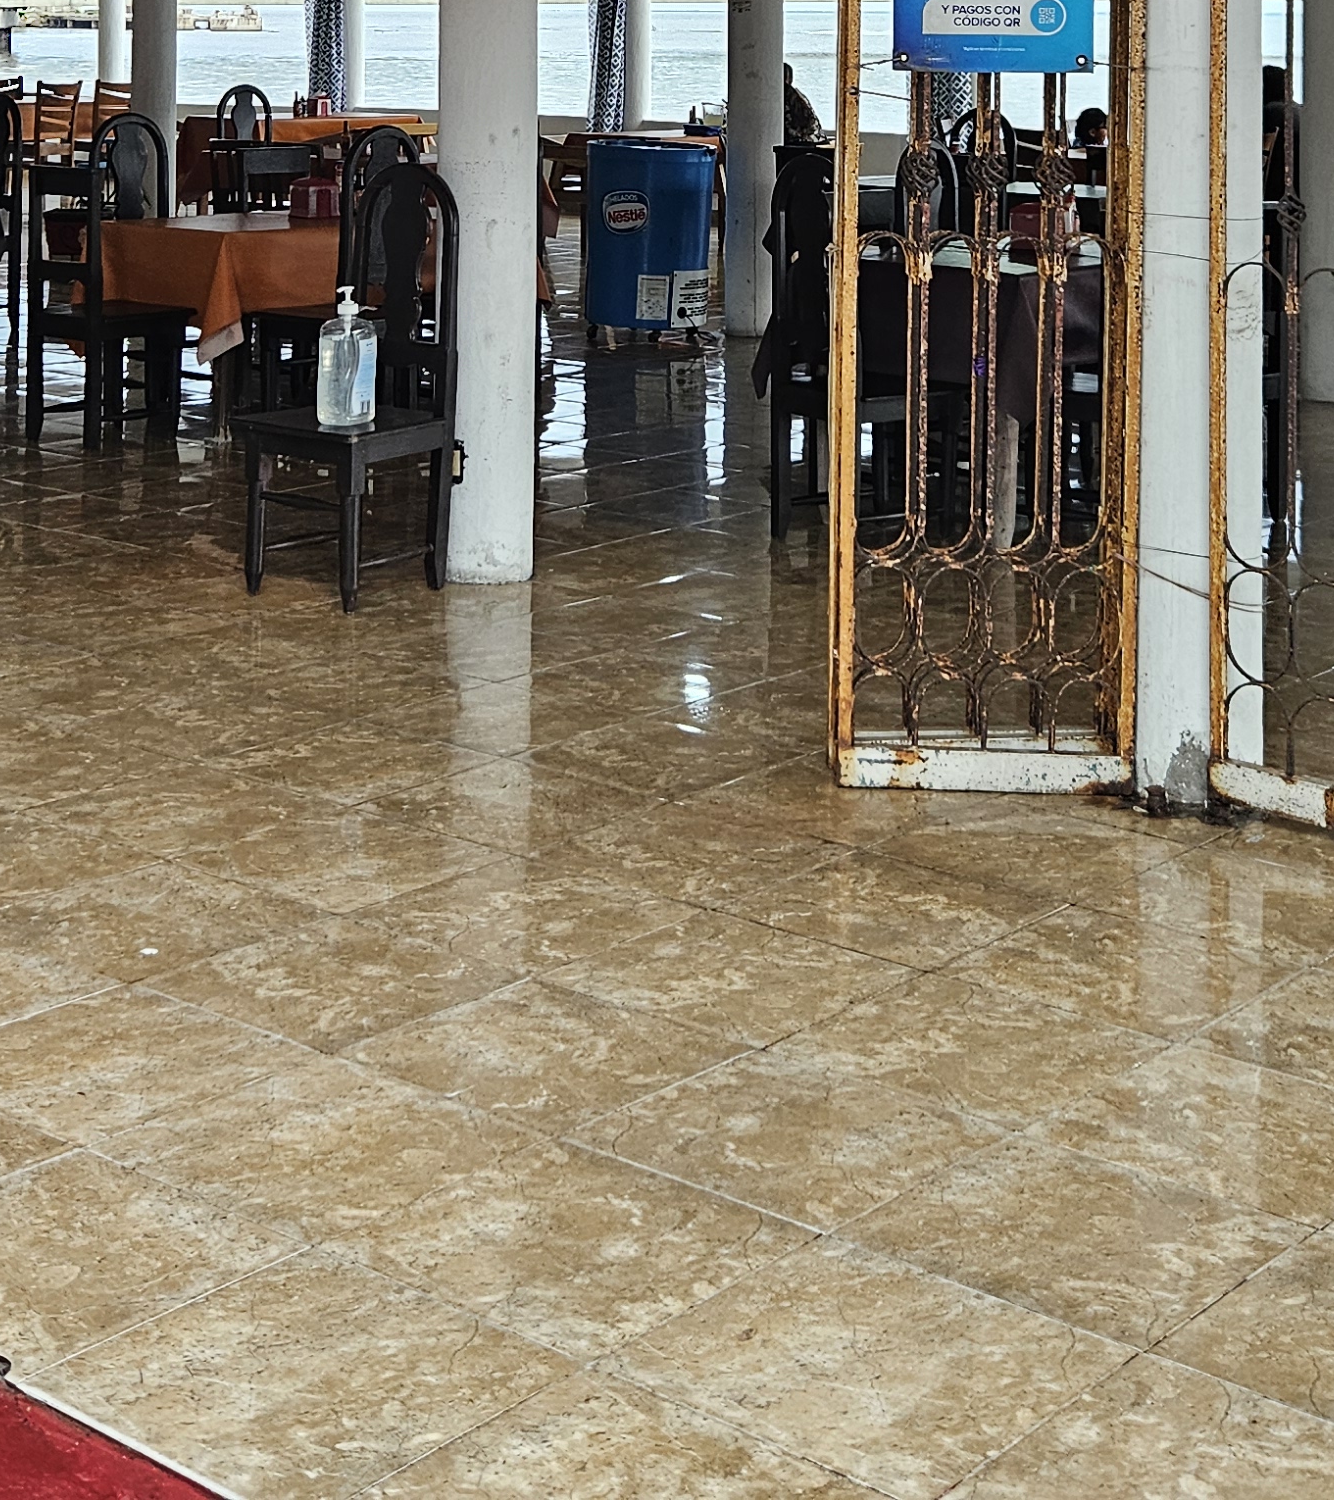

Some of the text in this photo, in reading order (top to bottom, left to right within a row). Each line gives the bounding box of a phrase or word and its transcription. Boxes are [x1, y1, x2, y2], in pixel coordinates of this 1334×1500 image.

[941, 4, 1021, 15] Y PAGOS CON
[953, 15, 1021, 27] CÓDIGO QR
[607, 207, 646, 224] Nestlé
